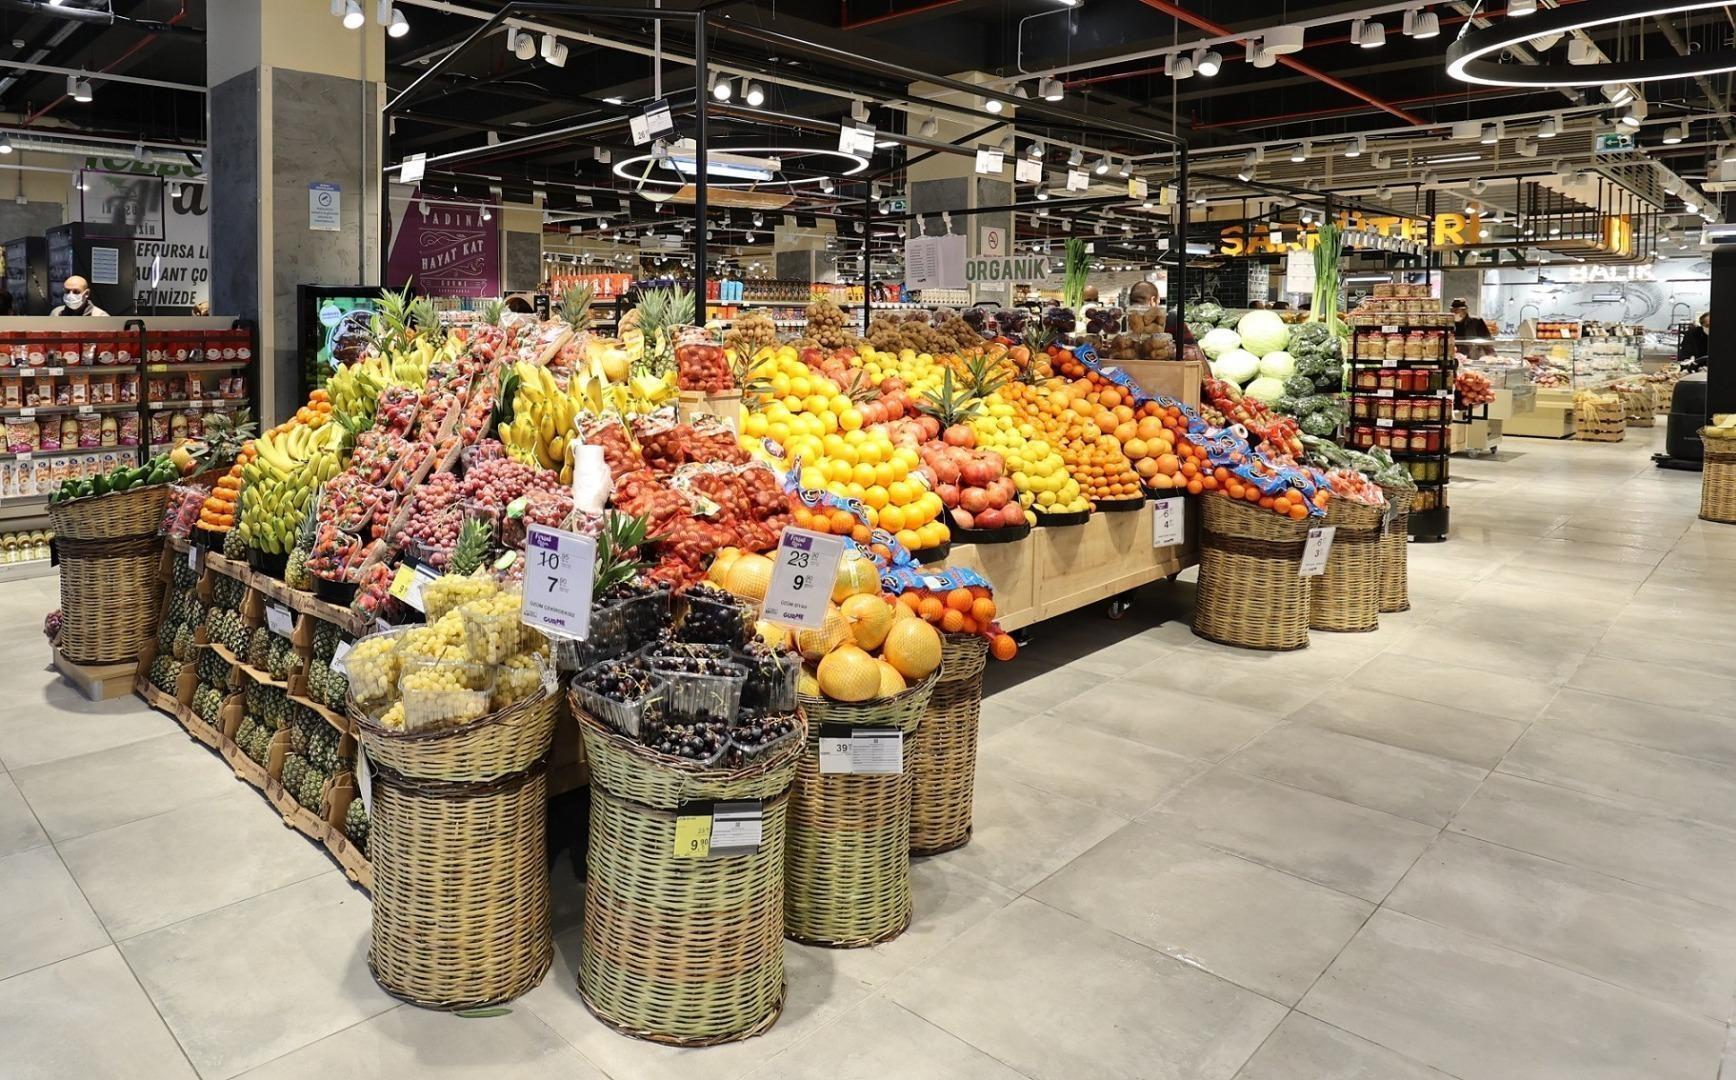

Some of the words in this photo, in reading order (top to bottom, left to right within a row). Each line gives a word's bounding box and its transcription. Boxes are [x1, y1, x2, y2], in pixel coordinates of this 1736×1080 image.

[421, 248, 457, 270] HAYAT
[462, 240, 484, 256] KAT
[966, 253, 1046, 280] ORGANİK
[540, 551, 559, 570] 10
[787, 550, 810, 568] 23
[547, 576, 559, 593] 7
[792, 574, 804, 591] 9
